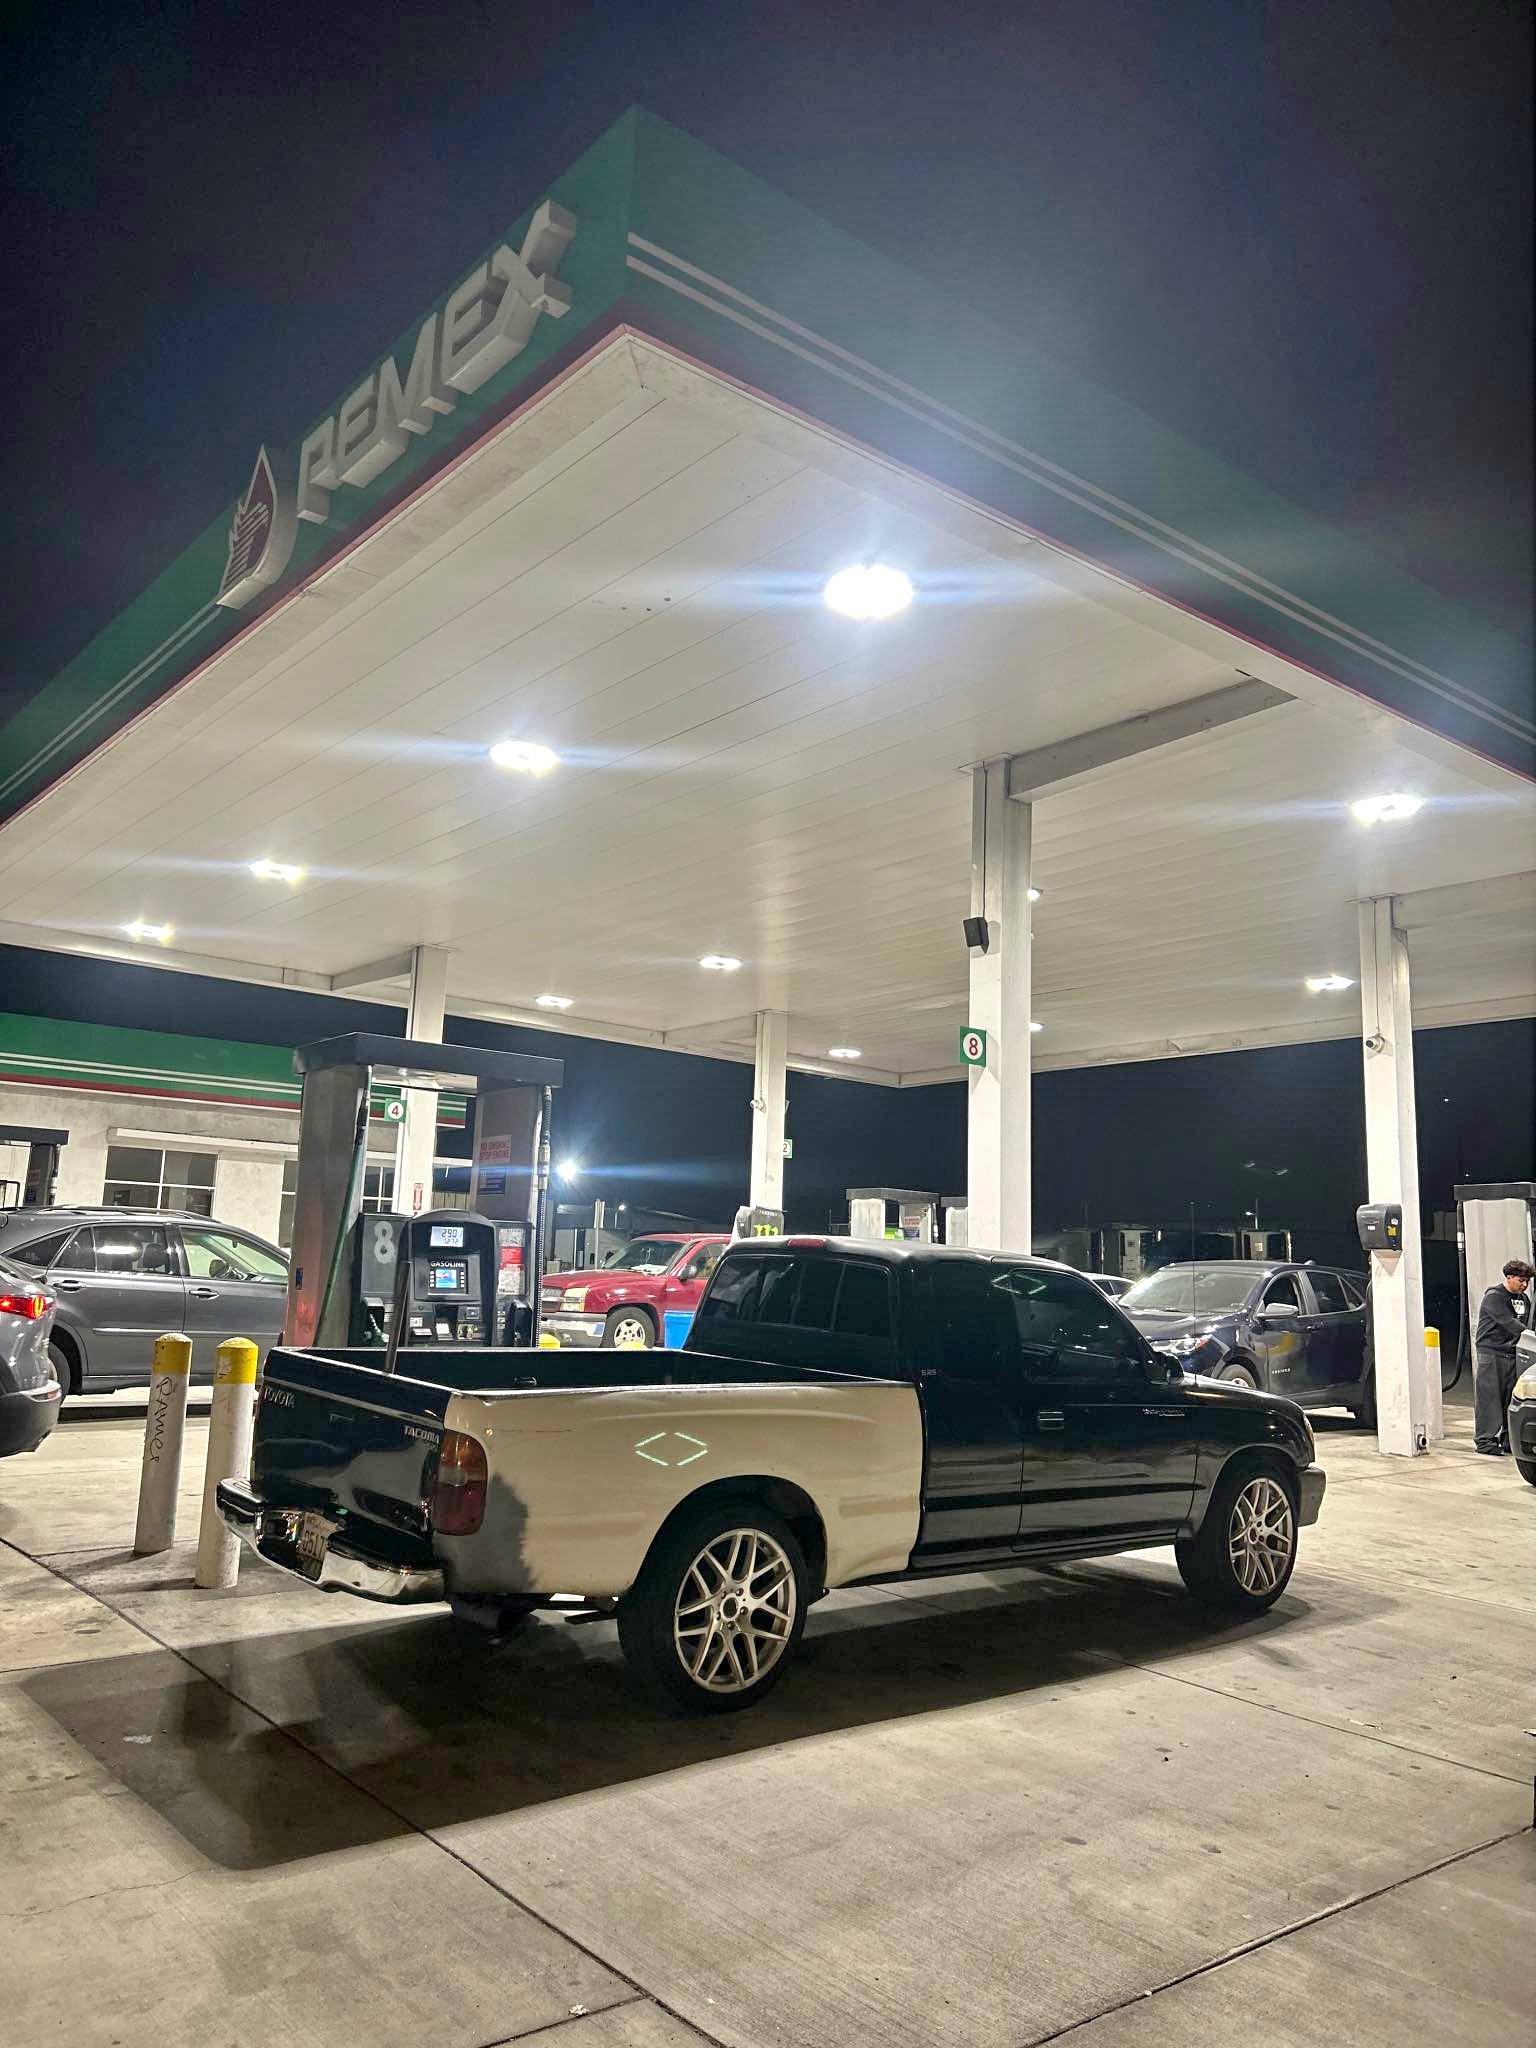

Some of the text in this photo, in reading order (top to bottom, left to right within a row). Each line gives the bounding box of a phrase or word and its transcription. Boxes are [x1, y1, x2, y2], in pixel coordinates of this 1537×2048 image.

[297, 200, 577, 525] PEMEX
[969, 1037, 978, 1056] 8
[391, 1105, 399, 1116] 4
[782, 1143, 788, 1153] 2
[374, 1221, 395, 1264] 8
[430, 1260, 465, 1268] GASOLINE
[404, 1425, 440, 1444] TACOMA
